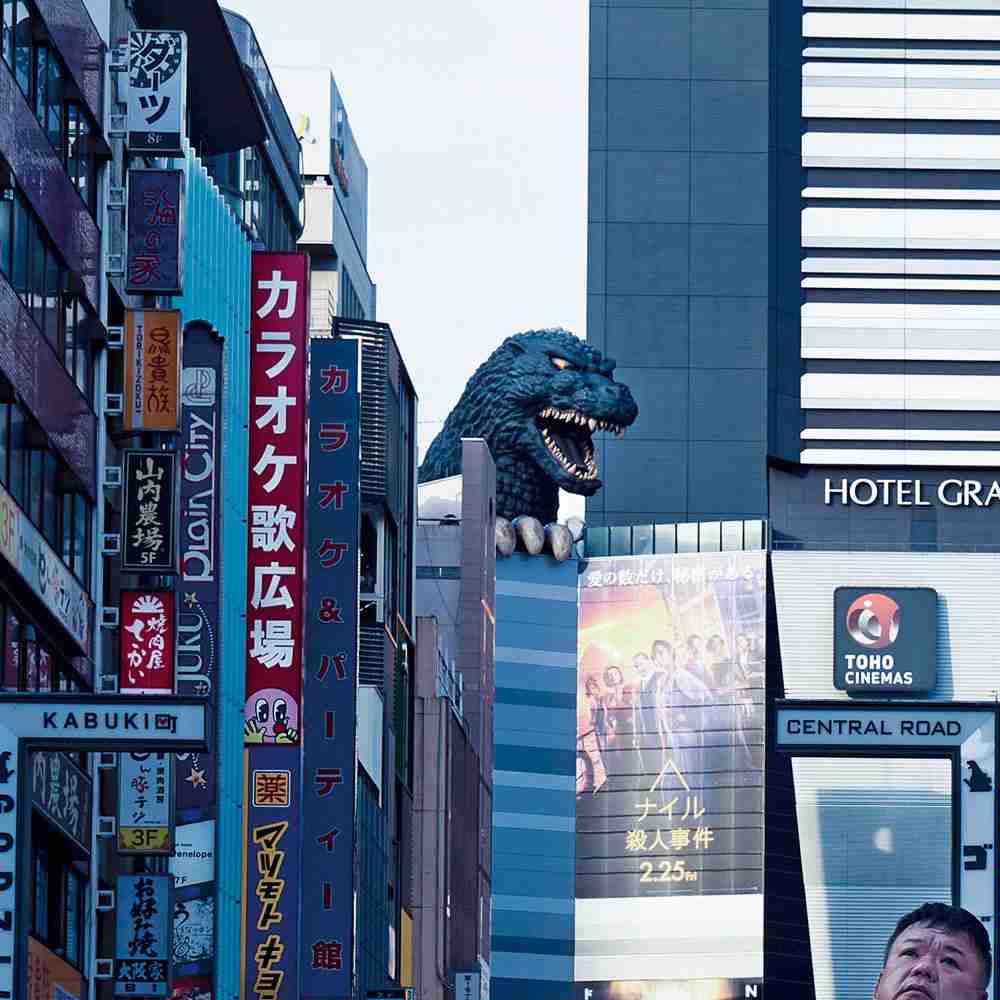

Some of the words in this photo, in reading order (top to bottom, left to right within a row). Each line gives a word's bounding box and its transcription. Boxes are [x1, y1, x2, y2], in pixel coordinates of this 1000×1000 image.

[139, 36, 175, 125] ダーツ
[251, 270, 298, 668] カラオケ歌広場
[132, 457, 165, 550] 山内農場
[824, 479, 930, 505] HOTEL
[140, 553, 157, 564] 5F
[311, 364, 350, 970] カラオケ&パーティー館
[845, 655, 894, 670] TOHO
[844, 671, 912, 684] CINEMAS
[787, 719, 892, 735] CENTRAL
[900, 719, 961, 736] ROAD
[257, 774, 286, 803] 薬
[635, 796, 705, 821] ナイル
[131, 829, 158, 846] 3F
[626, 827, 714, 850] 殺人事件
[640, 861, 685, 882] 2.25
